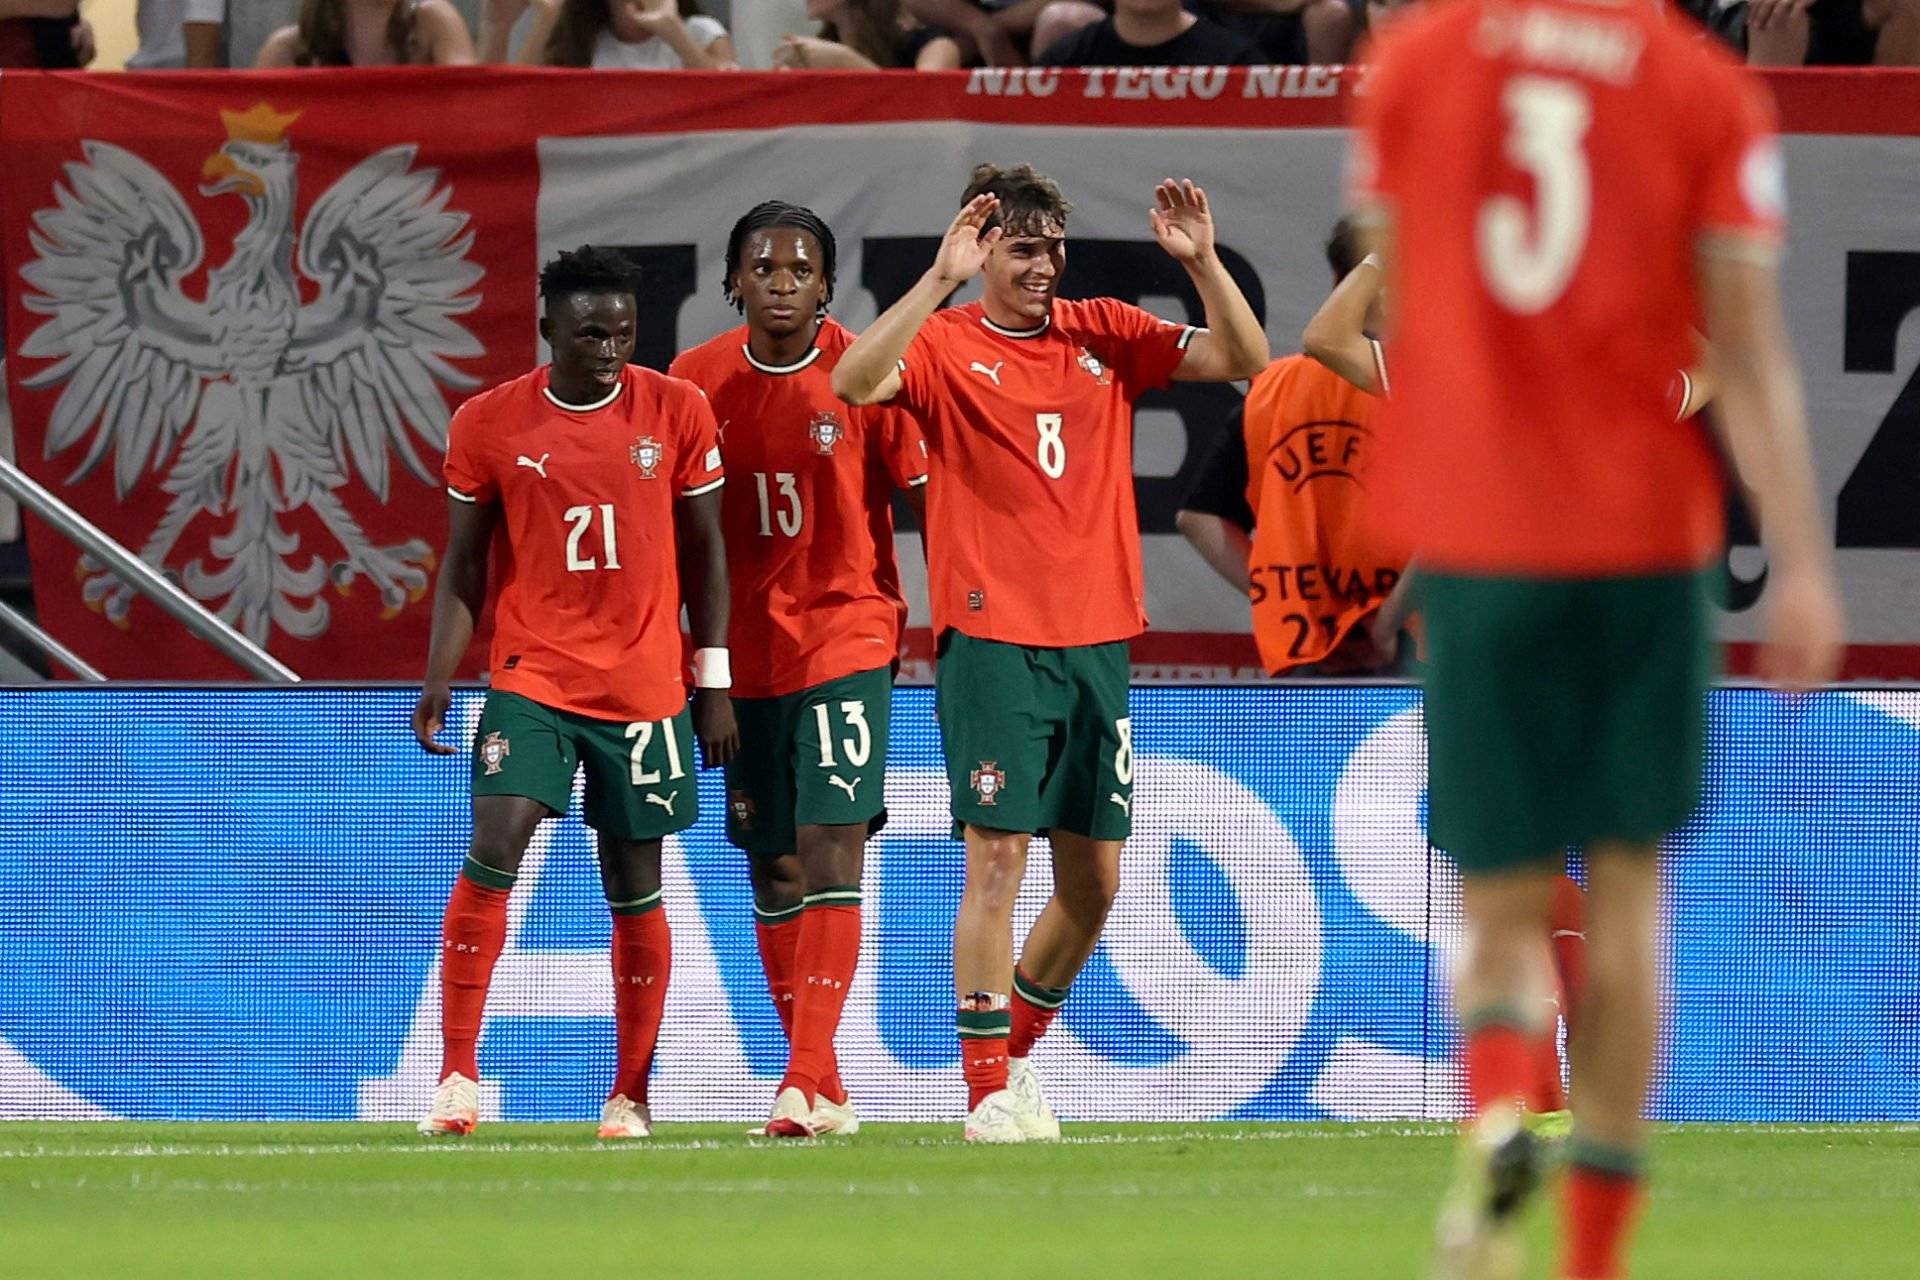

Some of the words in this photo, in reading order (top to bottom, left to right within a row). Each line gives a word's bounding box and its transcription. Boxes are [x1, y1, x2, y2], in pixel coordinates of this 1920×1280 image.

[1474, 72, 1596, 315] 3
[1036, 413, 1067, 479] 8
[1273, 432, 1366, 481] UEF
[563, 503, 621, 572] 21
[754, 472, 803, 537] 13
[624, 717, 686, 786] 21
[812, 700, 871, 767] 13
[1115, 717, 1132, 785] 8
